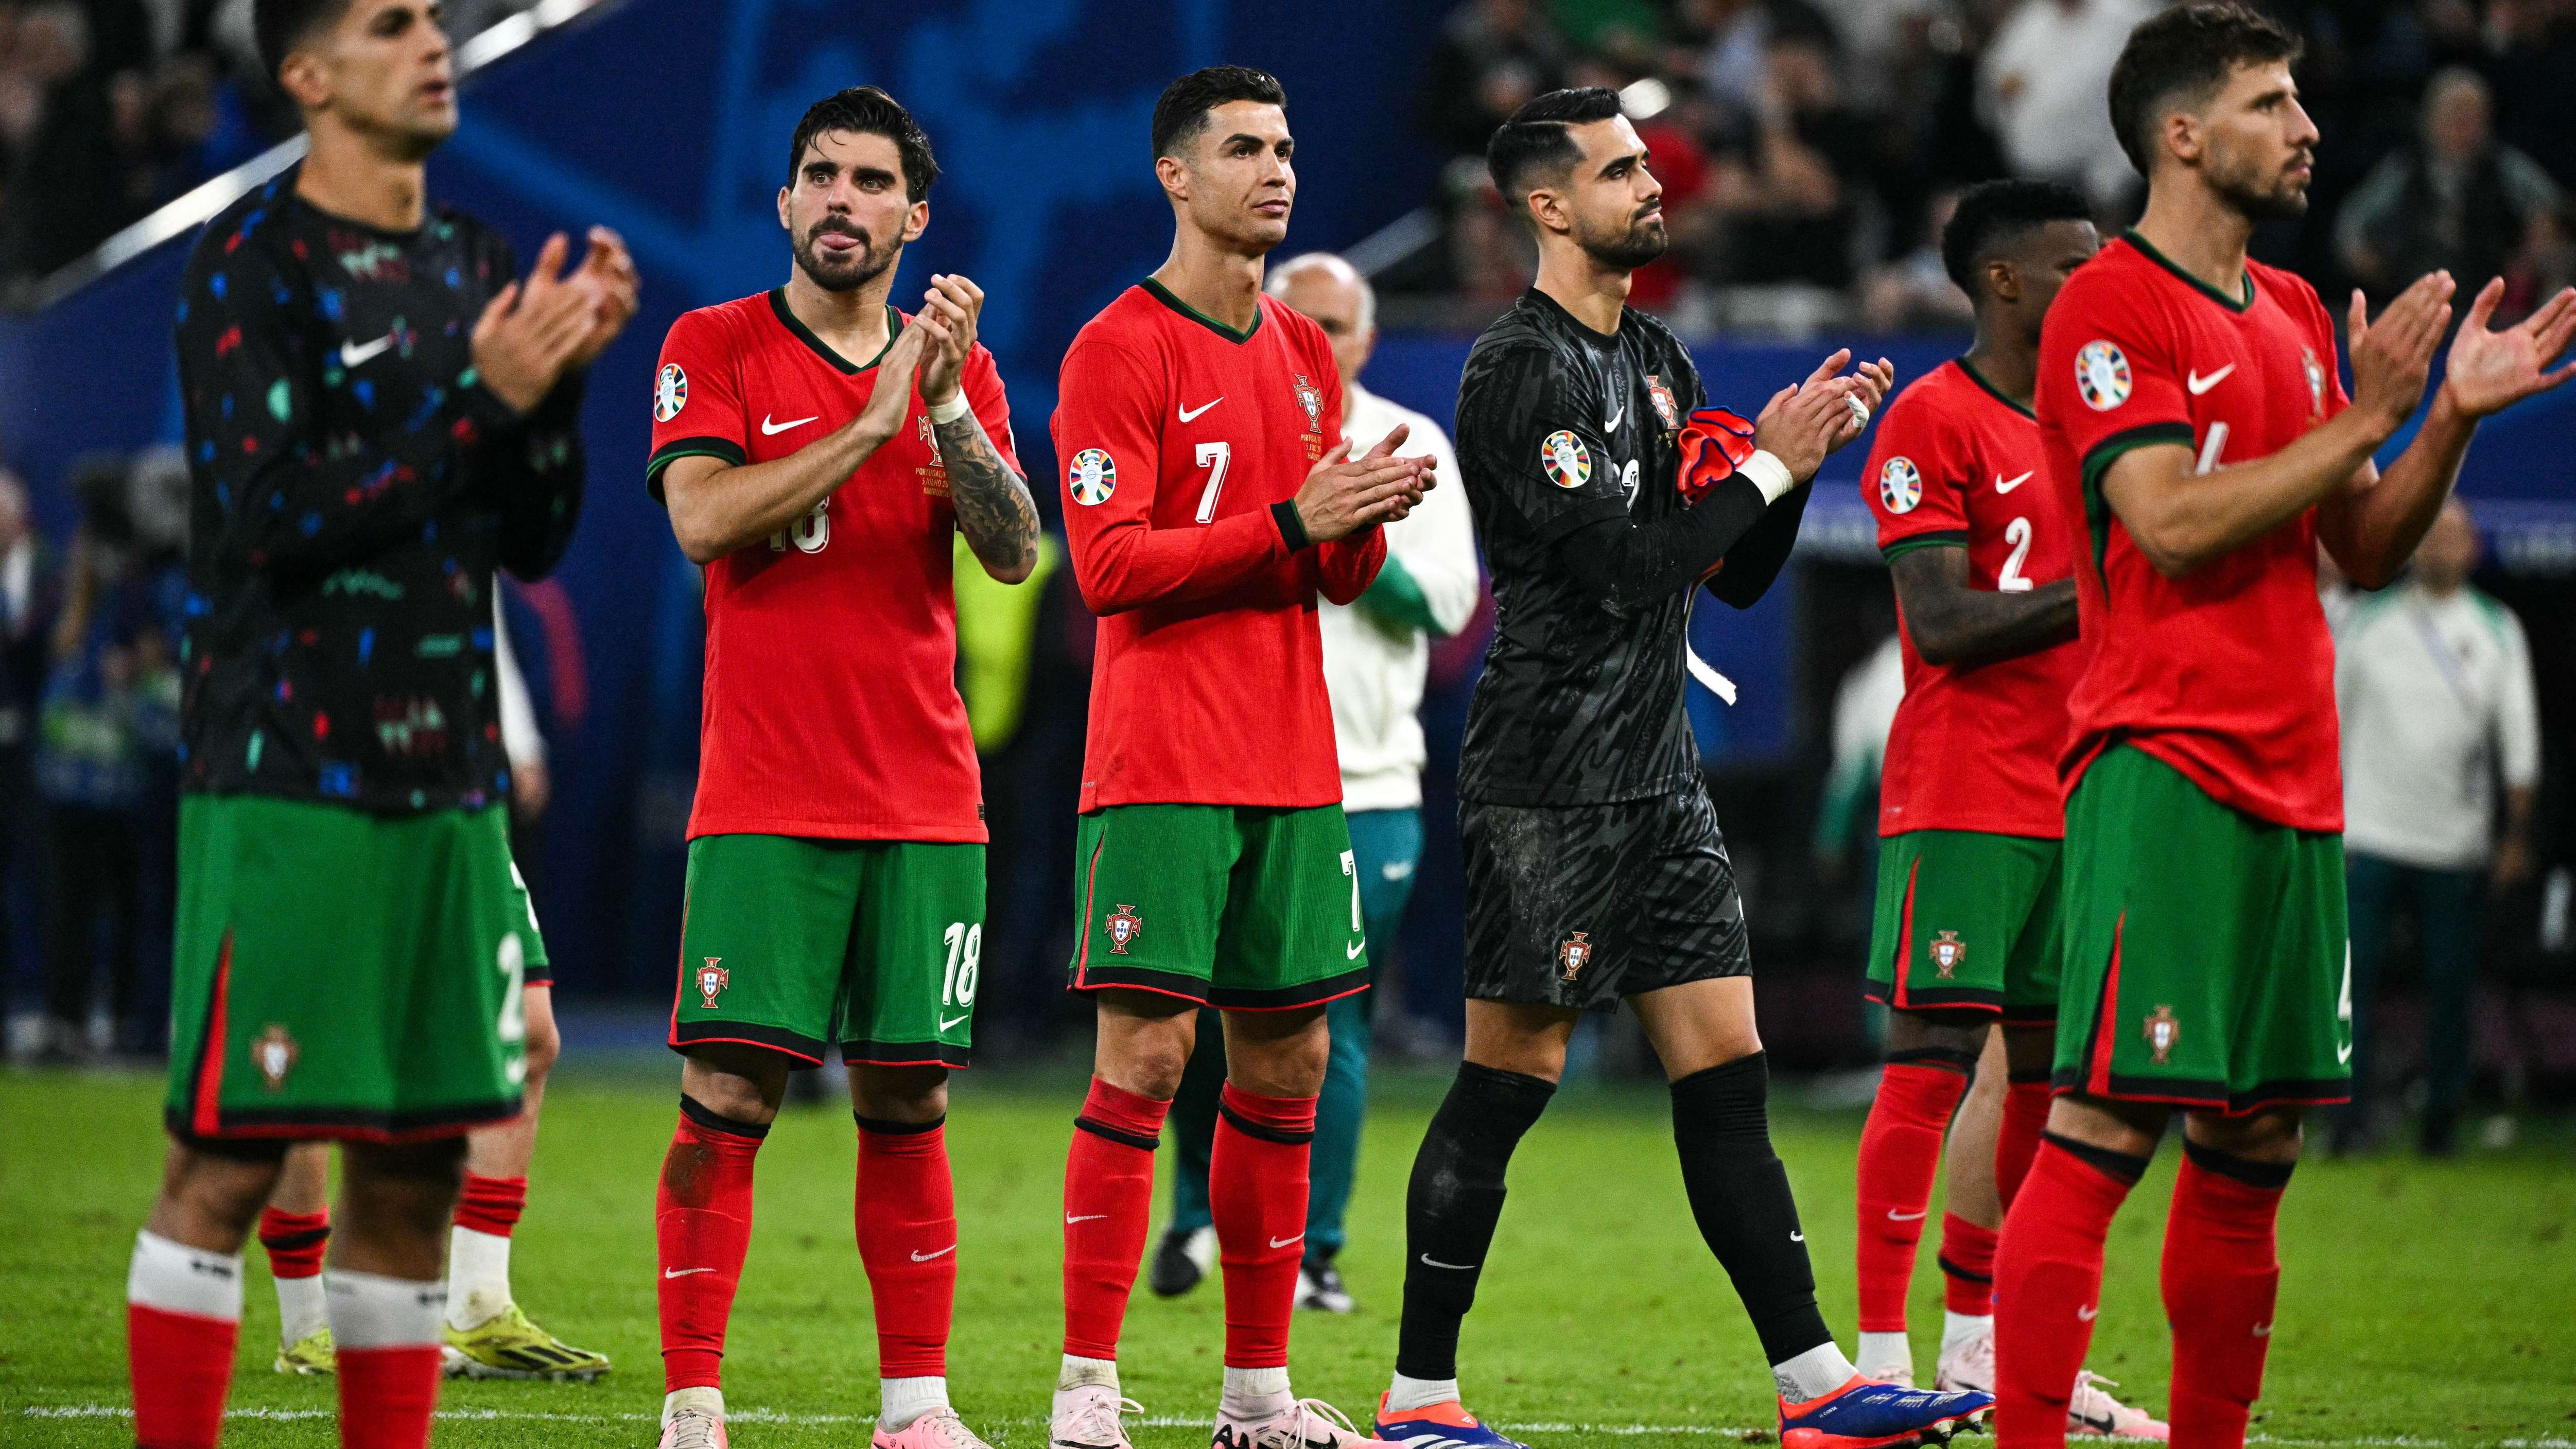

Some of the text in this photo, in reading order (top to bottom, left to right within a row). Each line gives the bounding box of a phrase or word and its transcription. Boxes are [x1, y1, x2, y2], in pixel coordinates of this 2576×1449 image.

[1195, 442, 1230, 523] 7
[1613, 459, 1640, 513] 2
[1998, 516, 2033, 593] 2
[1339, 849, 1360, 932] 7
[943, 922, 981, 1007] 18
